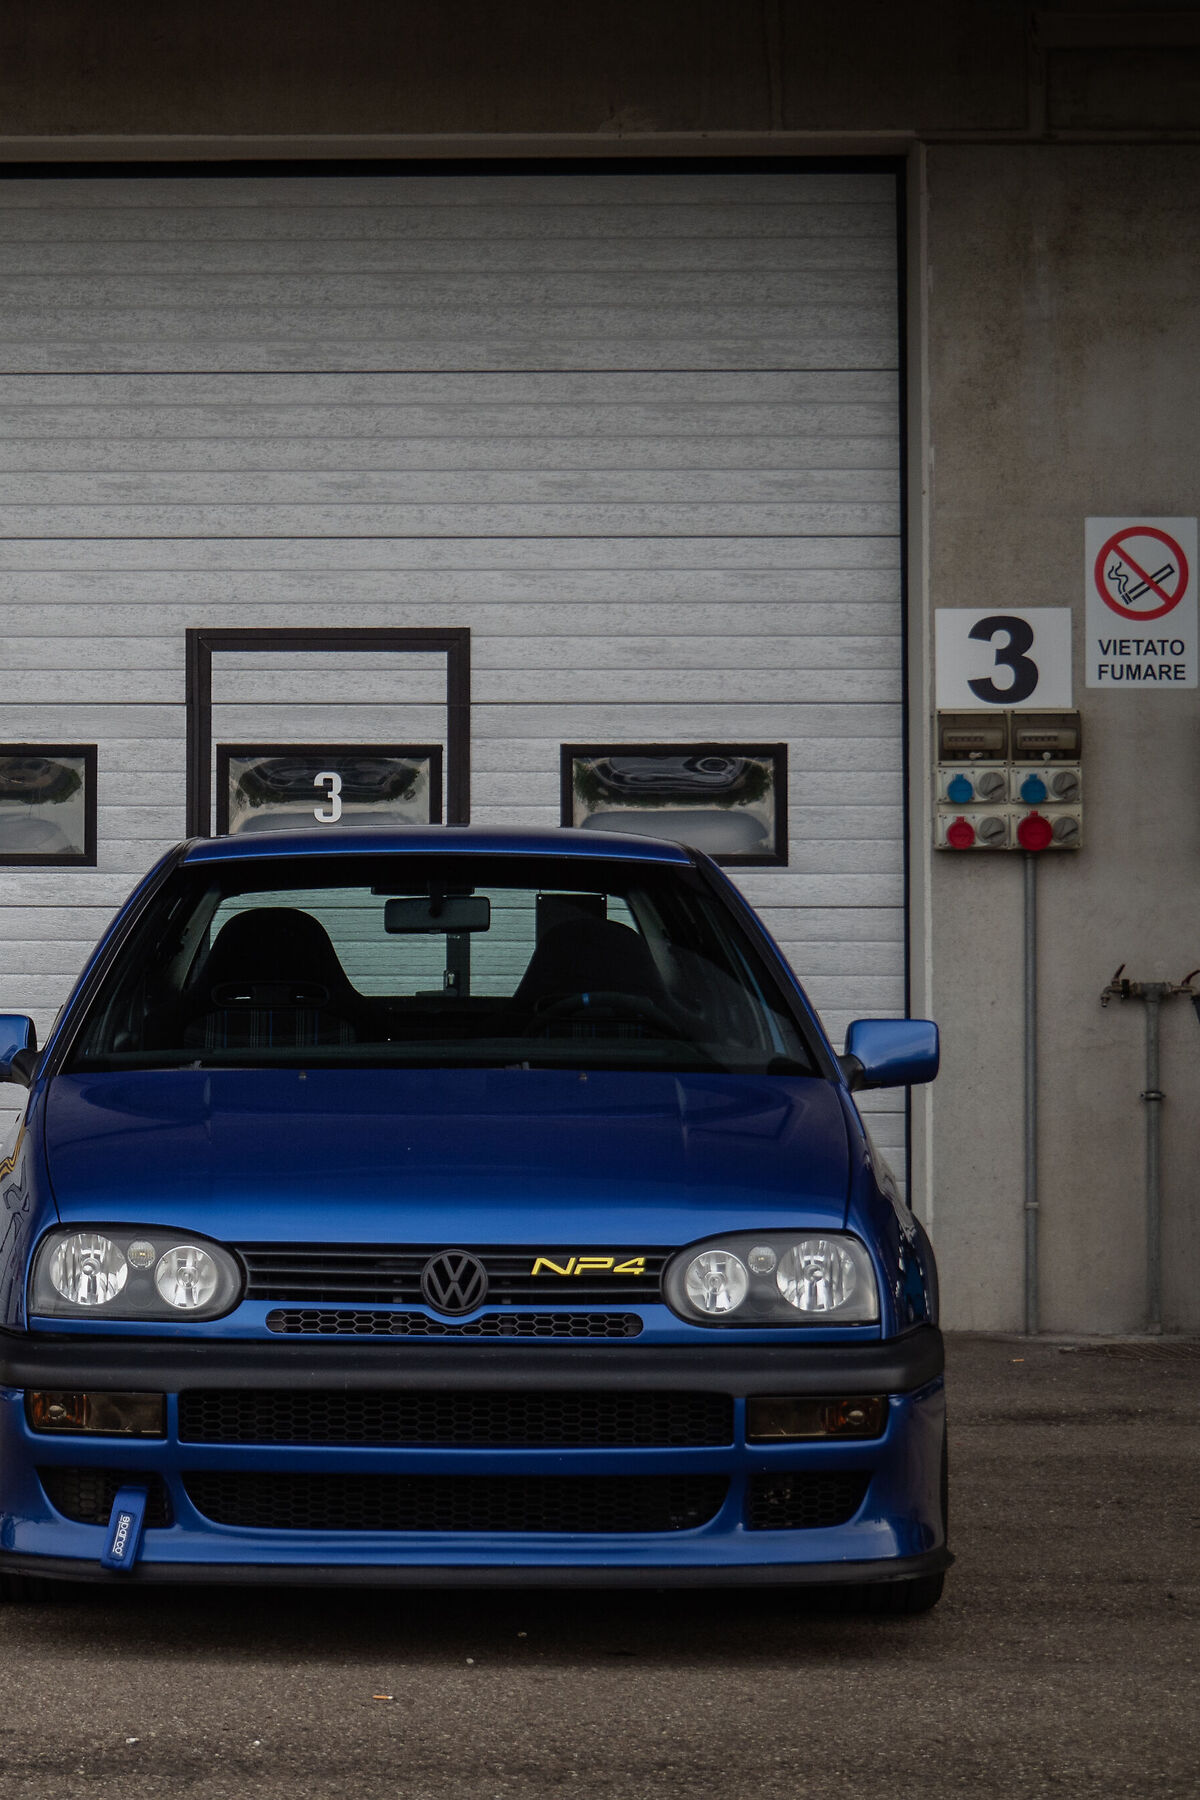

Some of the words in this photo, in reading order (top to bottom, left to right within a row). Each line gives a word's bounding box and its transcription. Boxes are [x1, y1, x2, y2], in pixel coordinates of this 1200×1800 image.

[967, 615, 1039, 705] 3
[1098, 639, 1186, 657] VIETATO
[1097, 663, 1187, 682] FUMARE
[313, 771, 342, 823] 3
[531, 1257, 646, 1276] NP4
[113, 1515, 131, 1555] sparco
